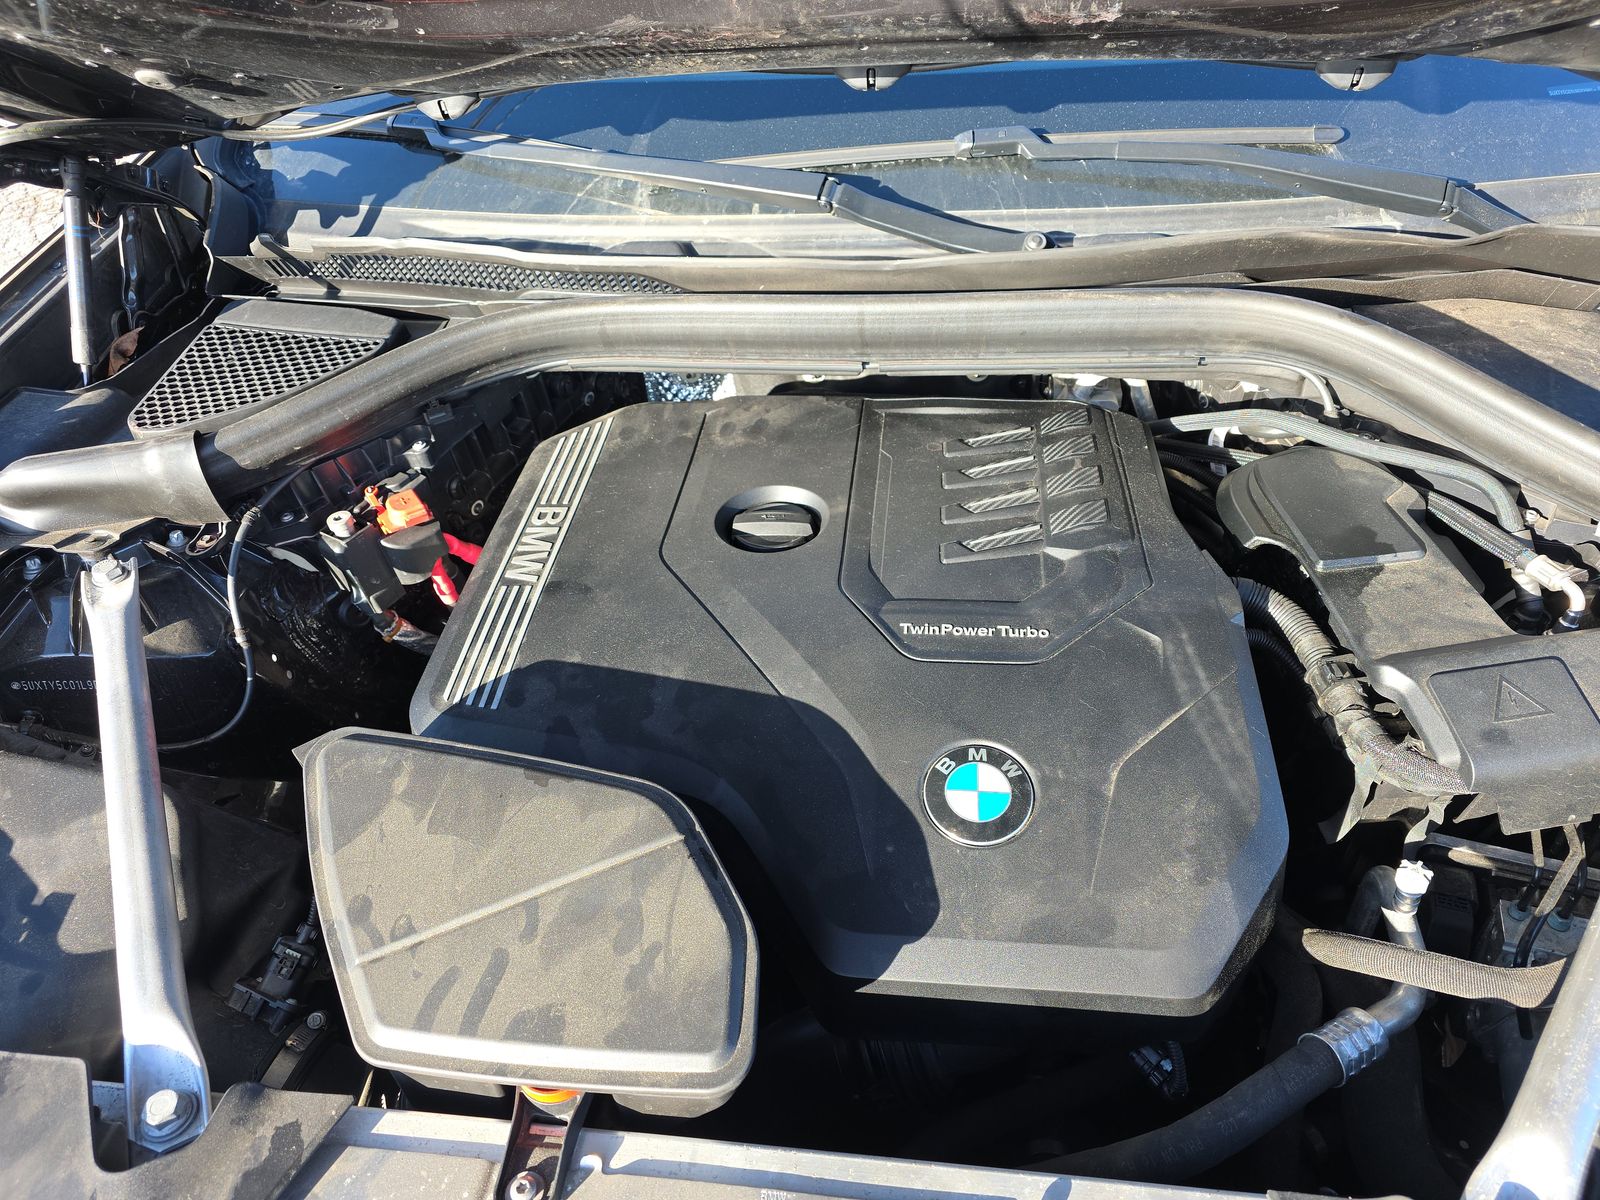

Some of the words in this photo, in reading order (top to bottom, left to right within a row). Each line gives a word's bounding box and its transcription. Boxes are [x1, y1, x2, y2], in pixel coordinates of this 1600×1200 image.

[505, 507, 569, 583] BMW
[900, 623, 995, 637] TwinPower
[997, 625, 1050, 638] Turbo
[935, 748, 1022, 778] BMW
